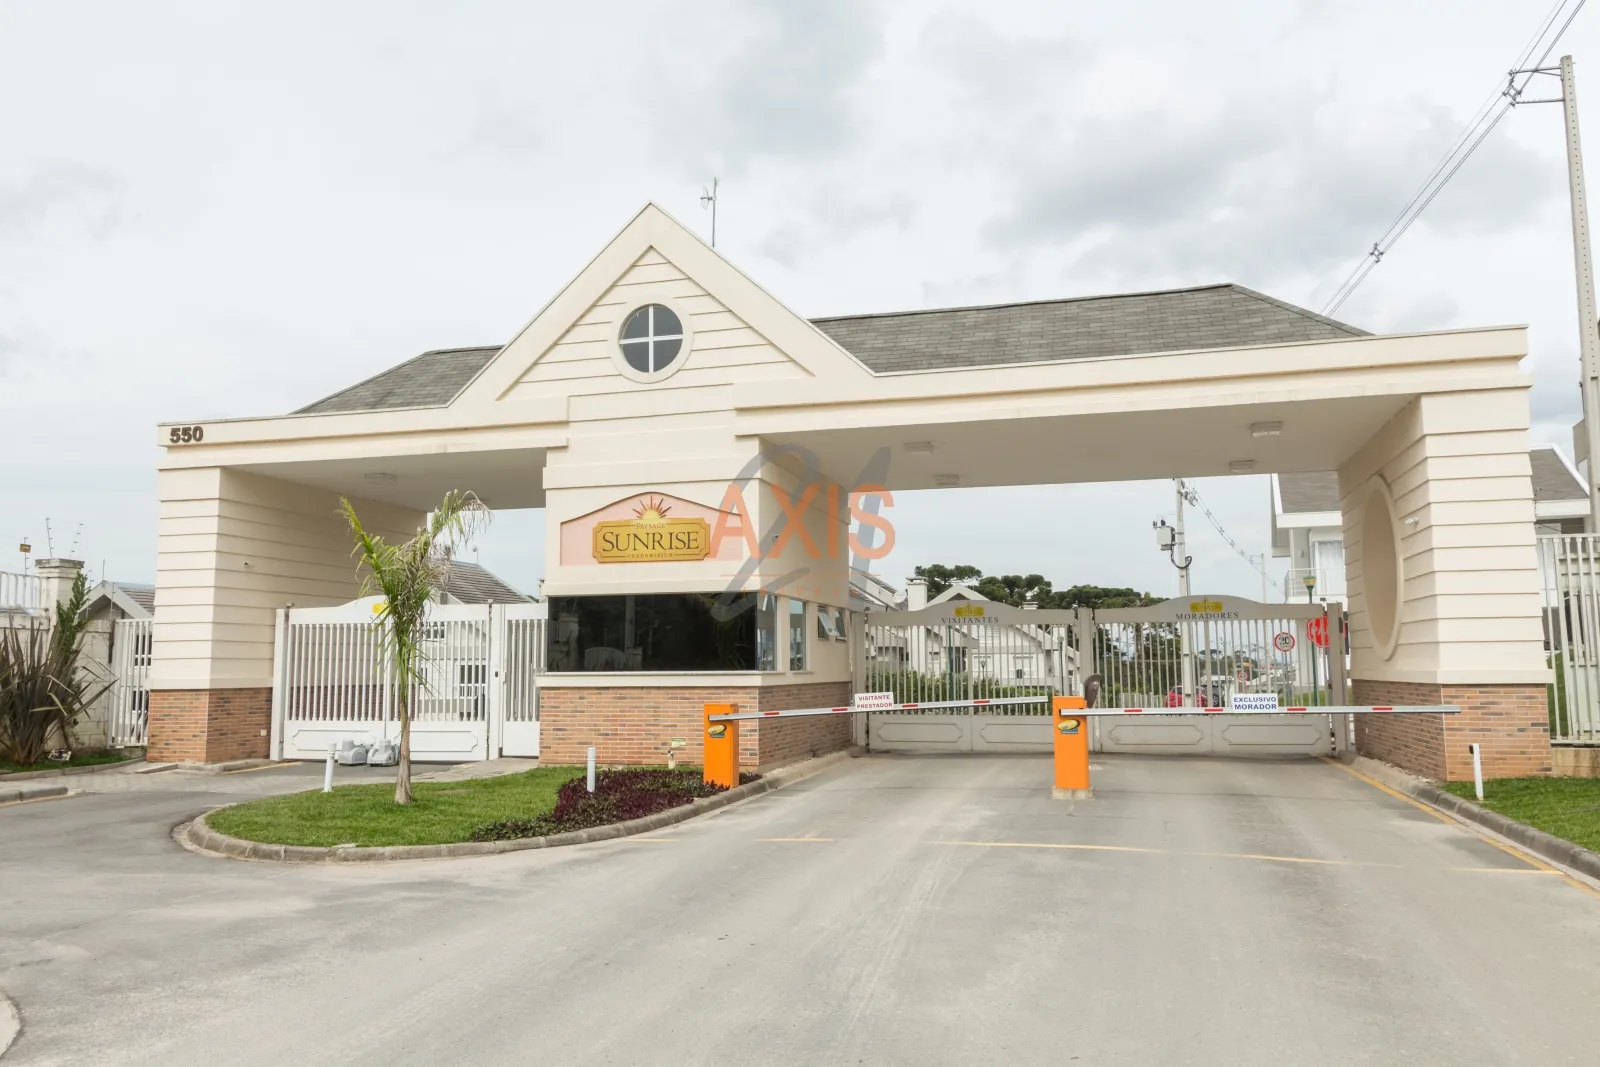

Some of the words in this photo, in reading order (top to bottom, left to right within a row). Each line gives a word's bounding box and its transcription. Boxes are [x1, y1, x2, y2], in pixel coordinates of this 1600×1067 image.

[170, 426, 203, 443] 550
[602, 531, 700, 552] SUNRISE
[941, 616, 999, 624] VISITANTES
[1175, 612, 1239, 620] MORADORES
